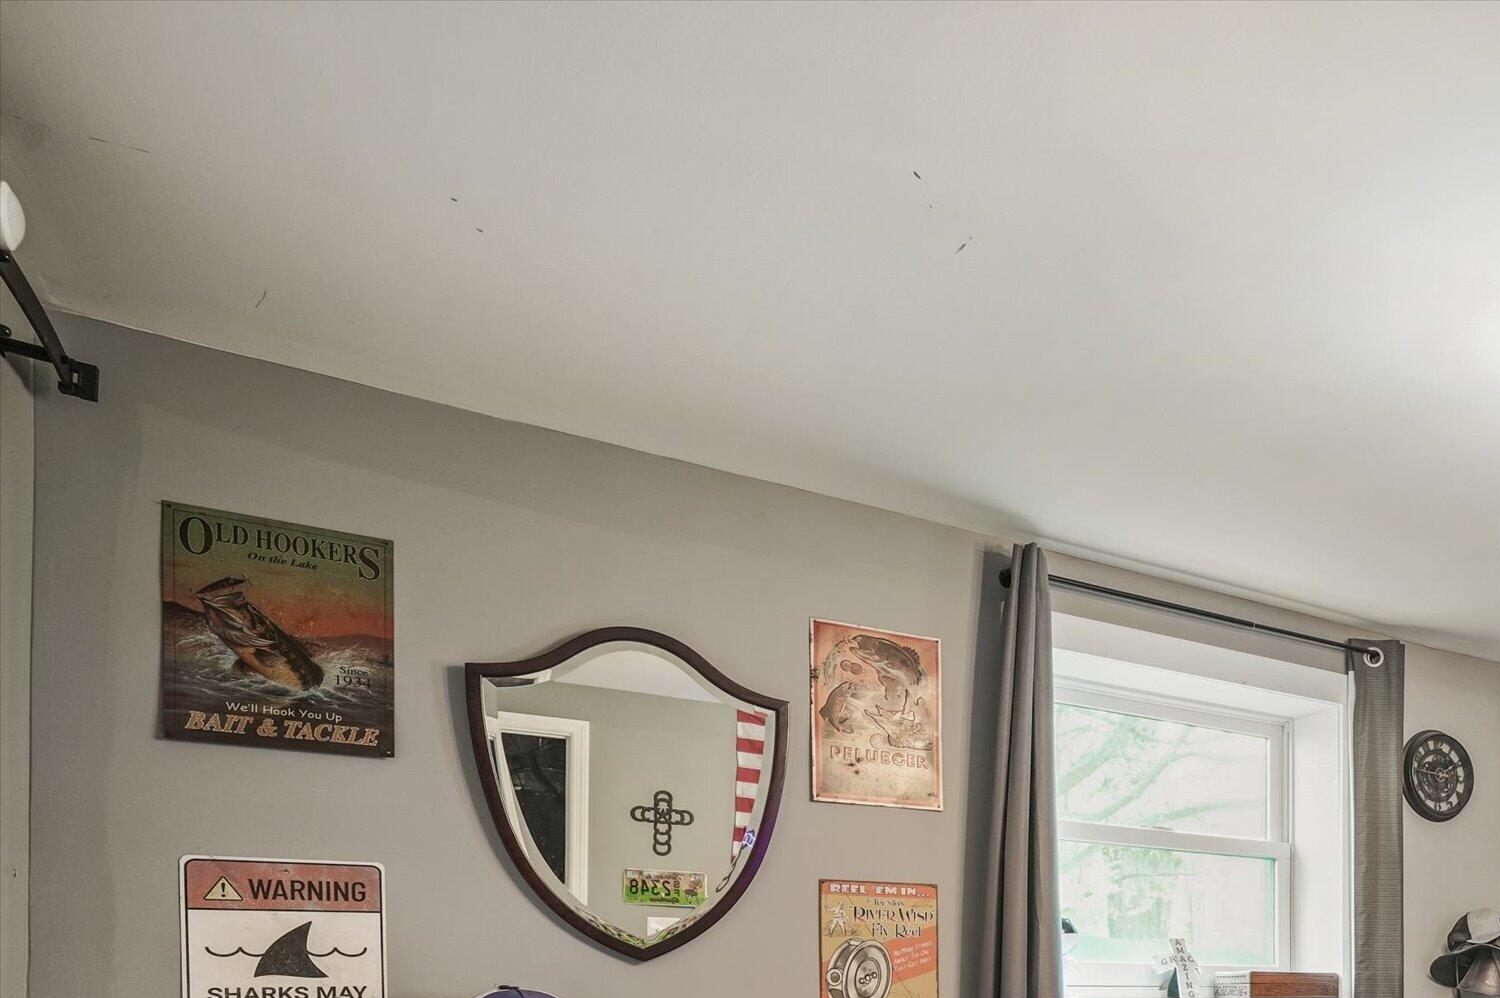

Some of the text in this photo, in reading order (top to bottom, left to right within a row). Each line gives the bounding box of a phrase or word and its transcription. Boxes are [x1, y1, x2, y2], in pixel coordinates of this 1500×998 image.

[178, 516, 381, 580] OLD HOOKERS
[247, 551, 319, 572] On the Lake
[339, 665, 369, 677] Since
[225, 701, 343, 723] We'll Hook You Up
[184, 710, 380, 747] BAIT & TACKLE
[248, 878, 367, 902] WARNING
[829, 883, 868, 894] REEL
